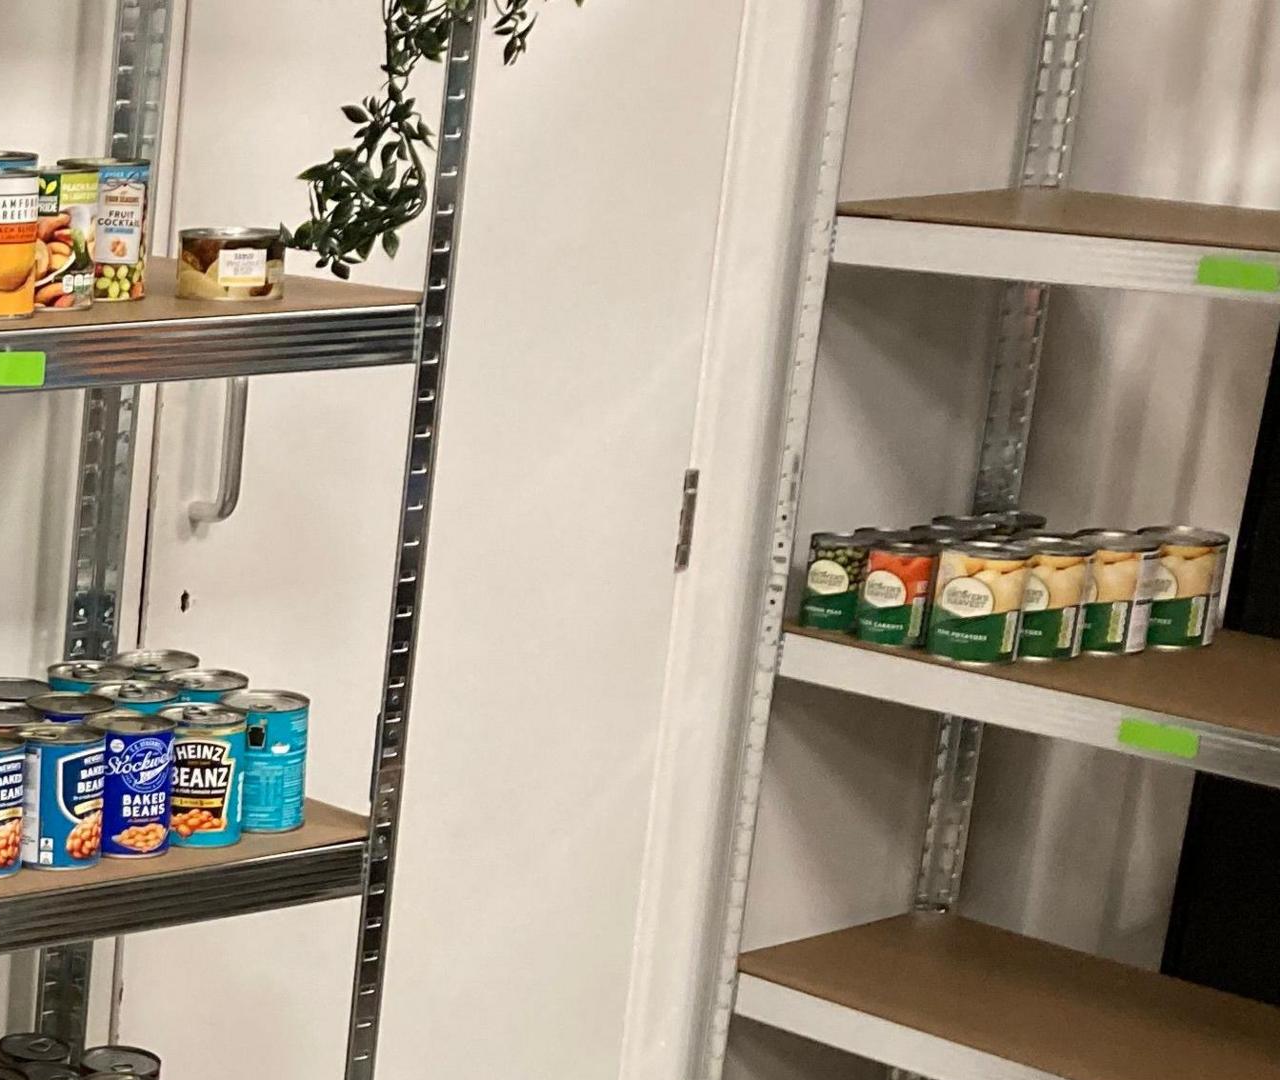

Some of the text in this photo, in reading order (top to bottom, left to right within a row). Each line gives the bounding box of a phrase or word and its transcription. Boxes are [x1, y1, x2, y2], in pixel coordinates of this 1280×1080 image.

[108, 210, 135, 218] FRUIT
[176, 744, 224, 761] HEINZ
[123, 792, 166, 806] BAKED
[123, 804, 166, 818] BEANS
